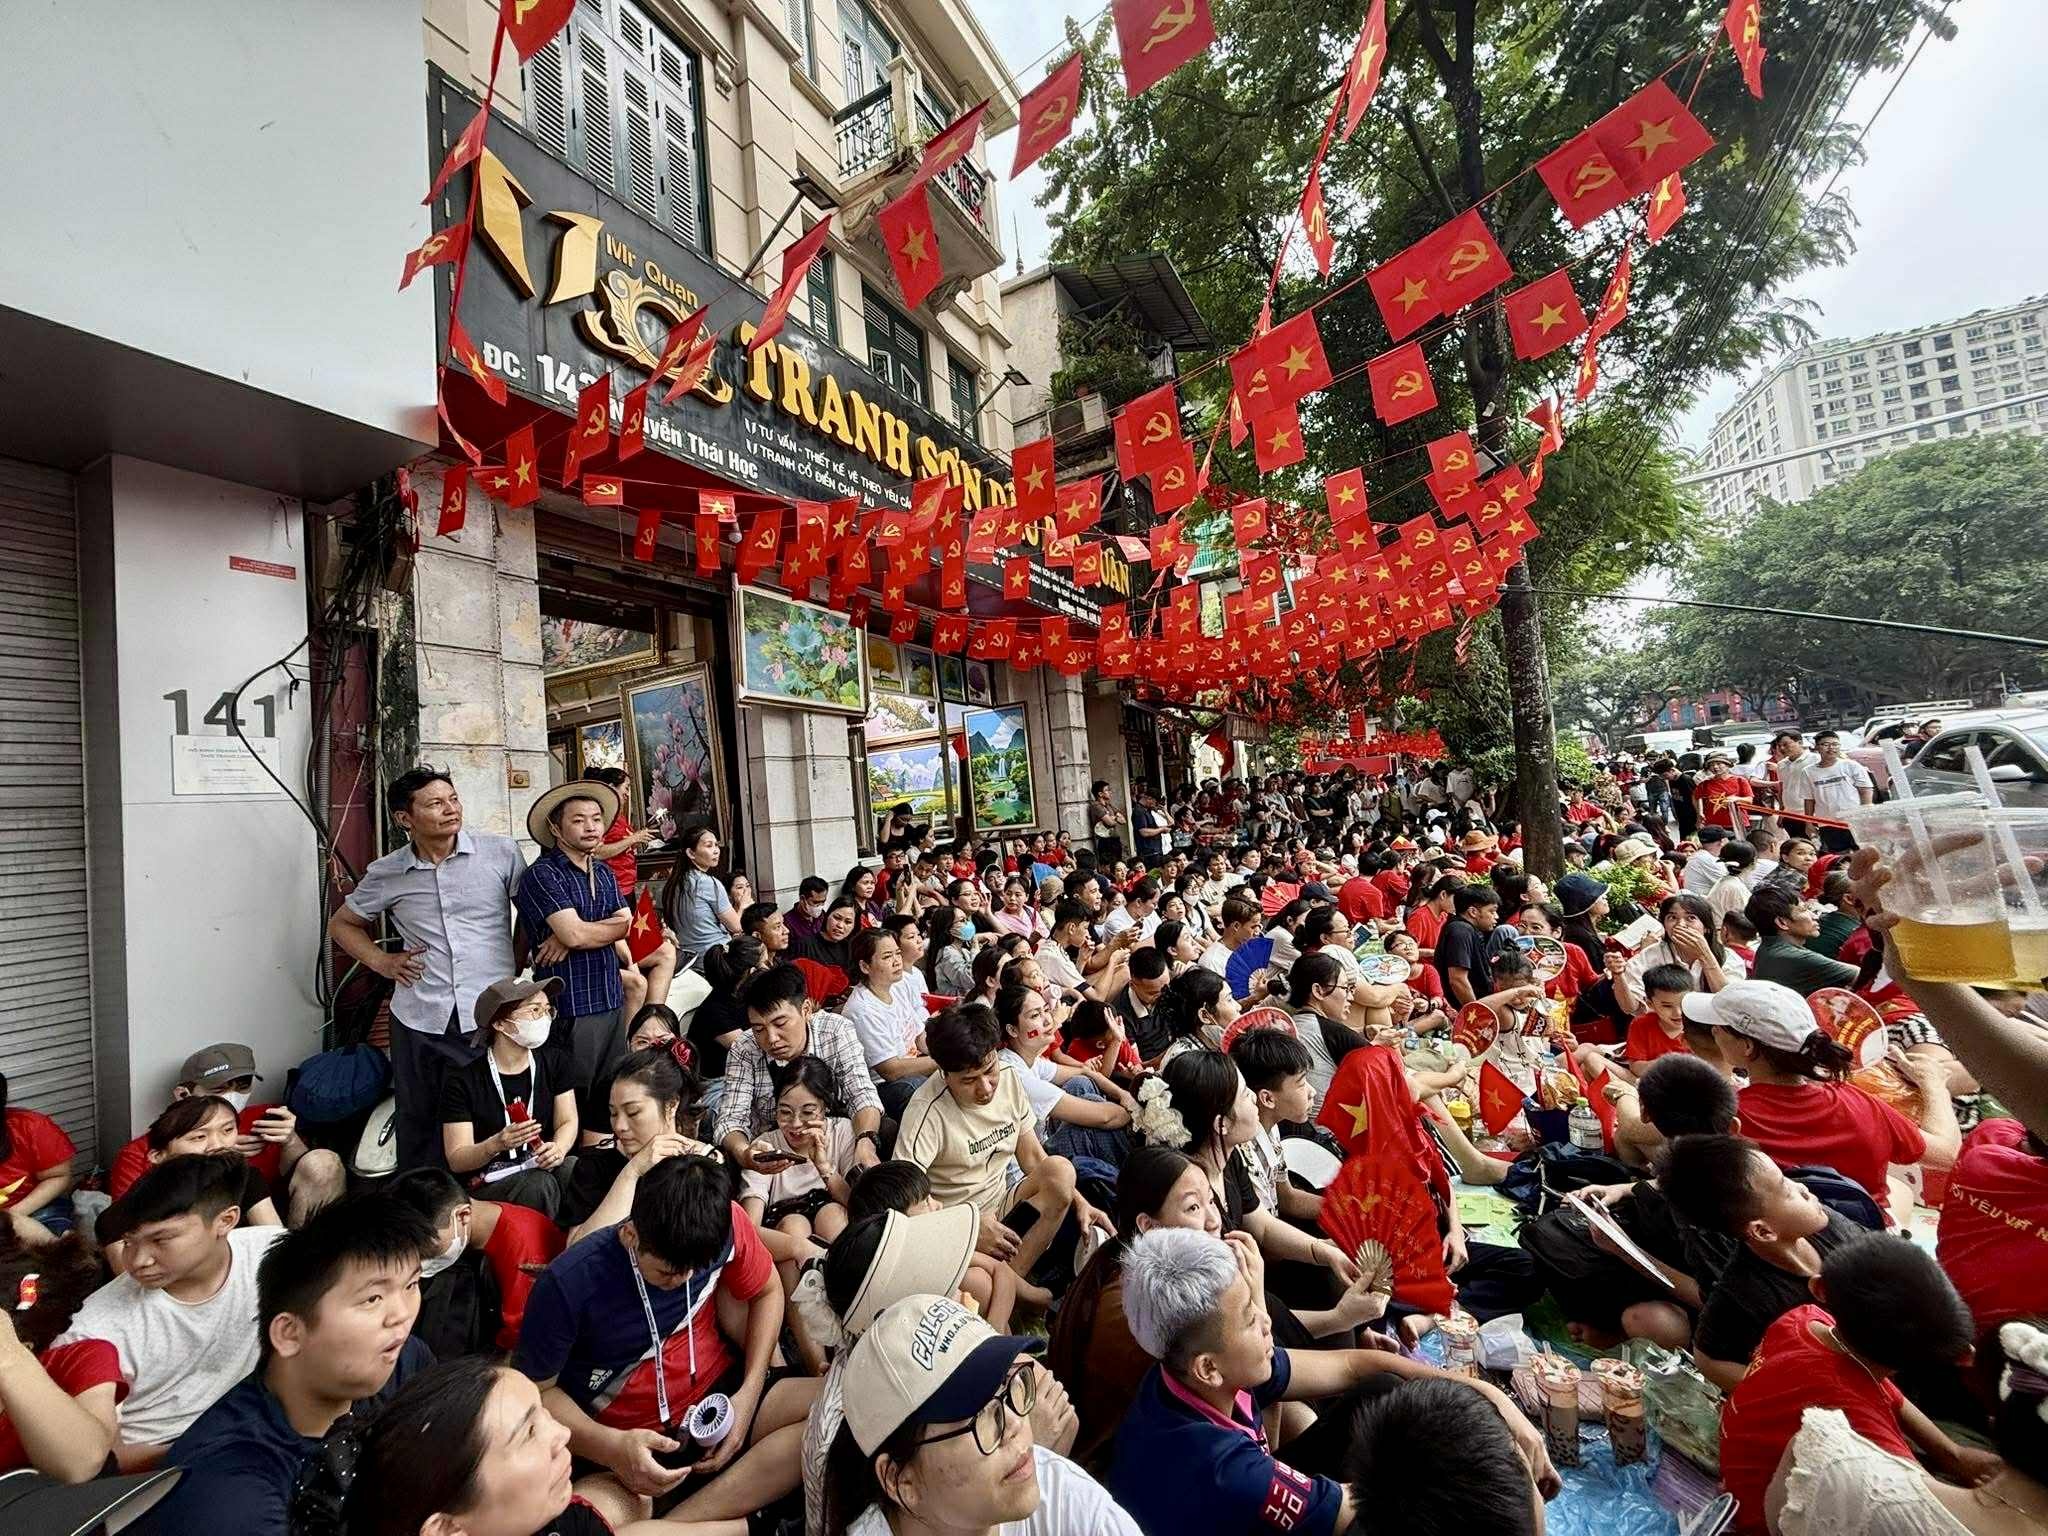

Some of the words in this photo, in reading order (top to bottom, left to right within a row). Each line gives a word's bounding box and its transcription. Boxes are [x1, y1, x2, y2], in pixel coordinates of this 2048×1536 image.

[606, 233, 636, 268] Mr
[644, 260, 699, 309] Quan
[482, 340, 527, 380] ĐC:
[687, 431, 724, 466] Thái
[728, 450, 759, 480] Học
[735, 320, 913, 478] TRANH
[914, 434, 982, 512] SƠN
[758, 424, 774, 441] TƯ
[777, 433, 797, 451] VẤN
[805, 448, 830, 469] THIẾT
[860, 475, 882, 495] THEO
[760, 444, 796, 471] TRANH
[1097, 546, 1130, 598] UÂN
[163, 688, 276, 738] 141
